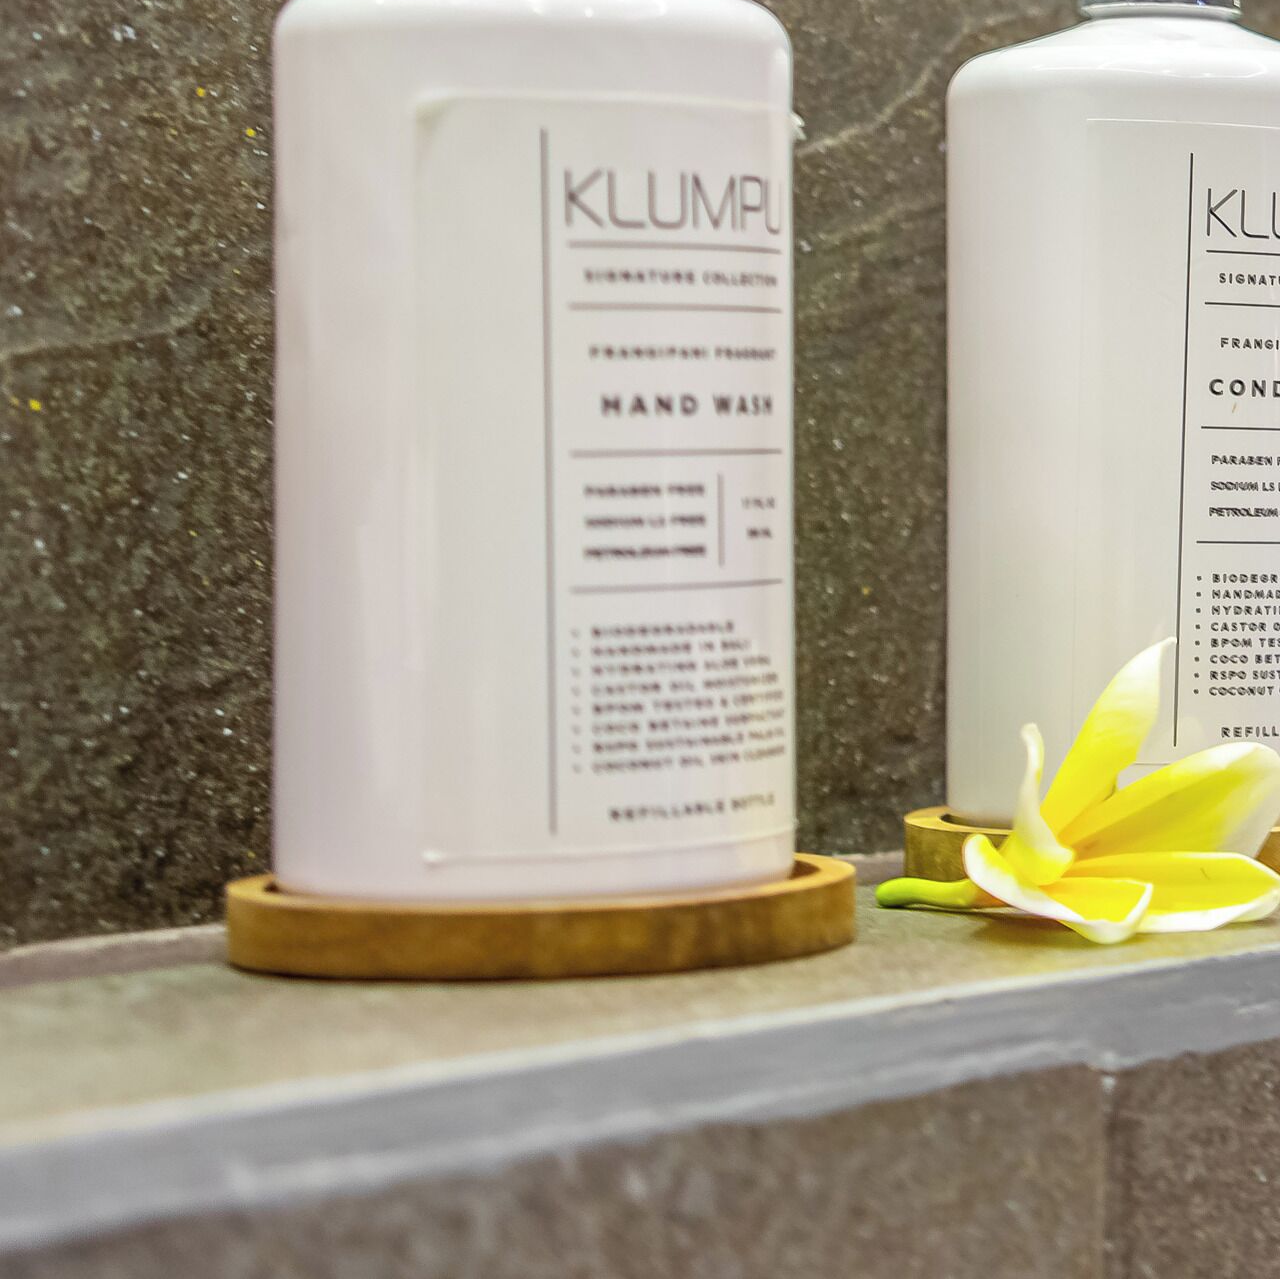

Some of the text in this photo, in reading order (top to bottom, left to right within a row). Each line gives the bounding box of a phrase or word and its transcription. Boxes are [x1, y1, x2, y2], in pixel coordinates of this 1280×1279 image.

[563, 169, 782, 235] KLUMPU
[600, 393, 774, 418] HAND WASH
[1211, 454, 1273, 466] PARABEN
[1210, 480, 1259, 492] SODIUM
[1262, 481, 1275, 492] LS
[1208, 506, 1279, 518] PETROLEUM
[1210, 622, 1267, 632] CASTOR
[1210, 637, 1253, 649] BPOM
[1209, 654, 1249, 665] COCO
[1209, 670, 1248, 682] RSPO
[1208, 686, 1275, 697] COCONUT
